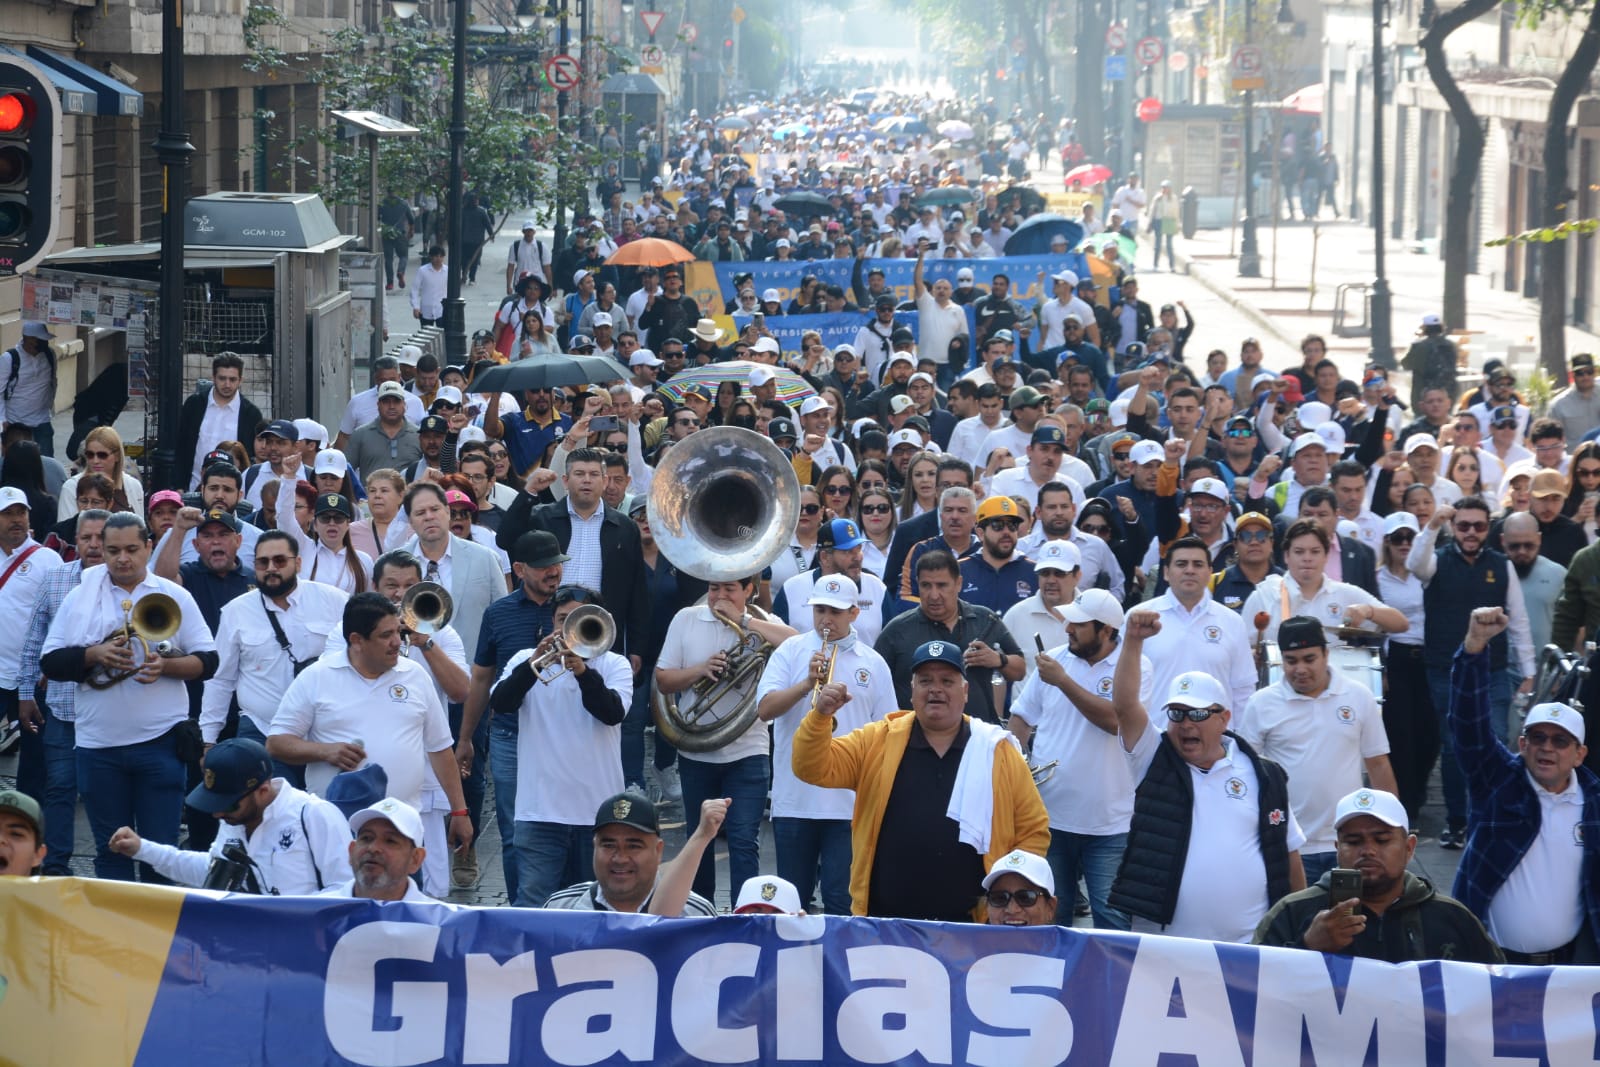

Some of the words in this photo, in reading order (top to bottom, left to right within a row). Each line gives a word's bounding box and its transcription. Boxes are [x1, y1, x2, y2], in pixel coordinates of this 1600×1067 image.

[242, 229, 287, 237] GCM-102
[728, 266, 849, 279] UIVERSIDAD
[828, 325, 860, 335] AUTÓ
[324, 914, 1074, 1067] Gracias
